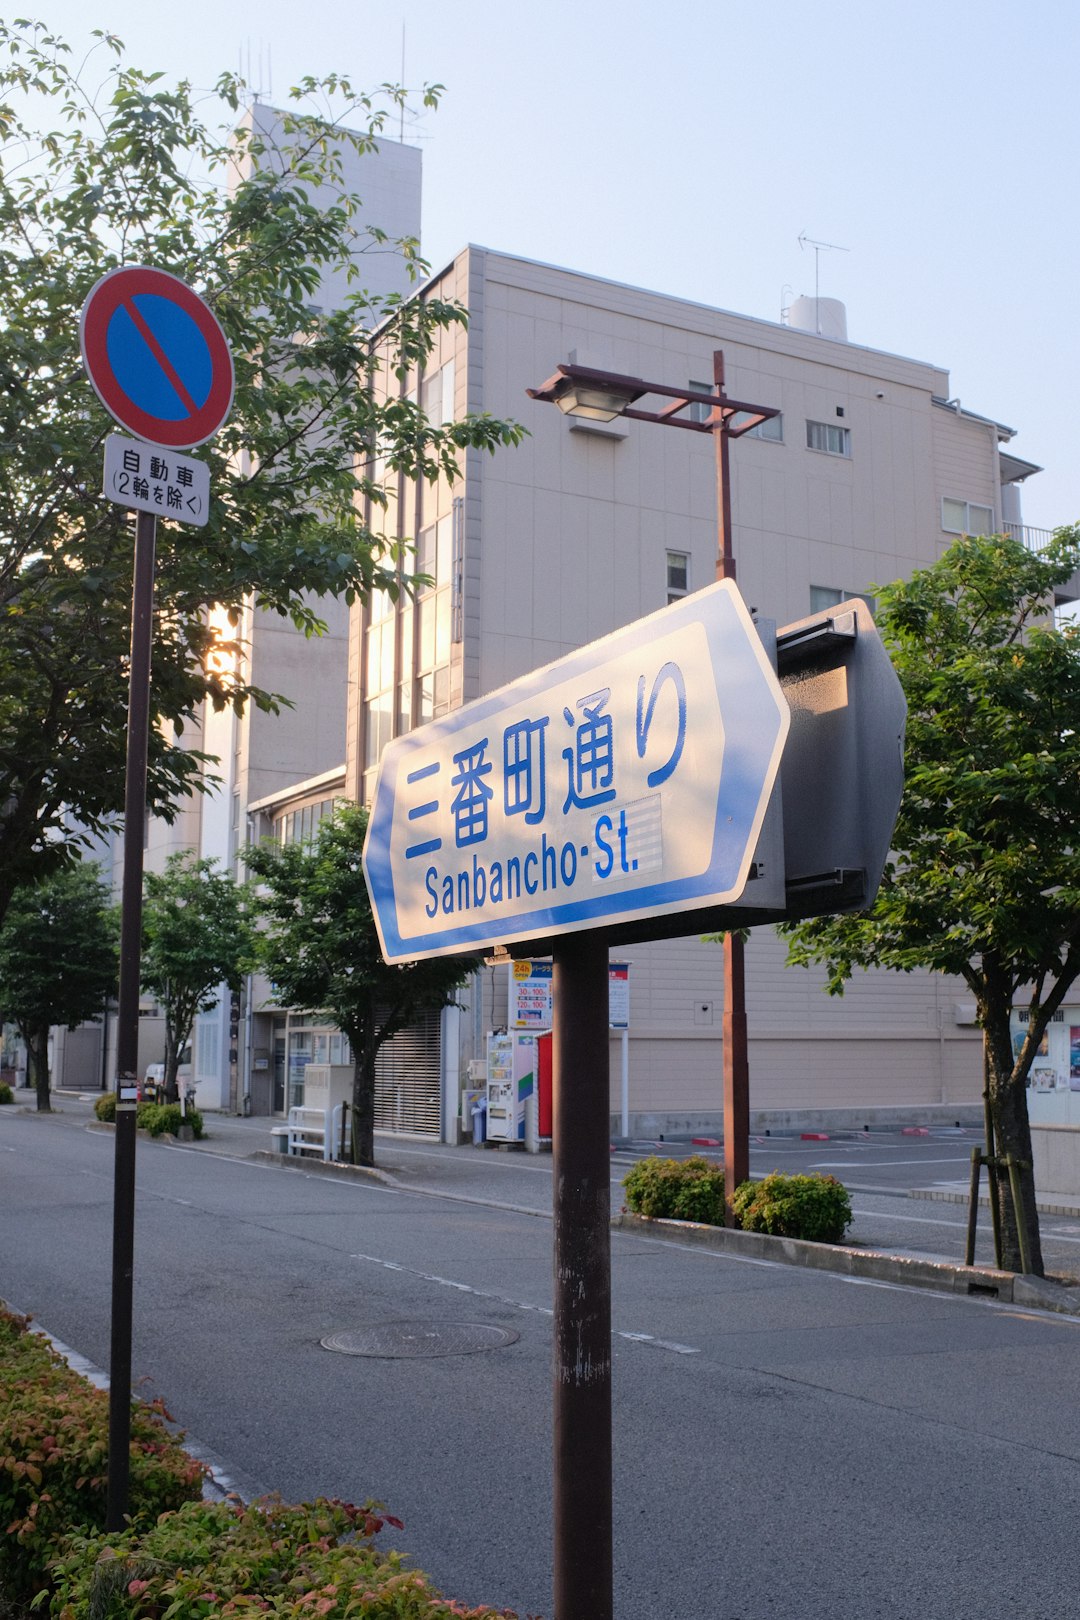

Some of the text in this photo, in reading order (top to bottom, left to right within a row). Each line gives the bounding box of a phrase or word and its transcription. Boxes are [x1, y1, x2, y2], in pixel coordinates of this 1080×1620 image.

[123, 449, 194, 488] 自動車
[113, 469, 202, 515] (2輪を除く)
[405, 661, 687, 860] 三番町通り
[514, 964, 530, 973] 24h
[532, 964, 552, 973] パークラ
[1018, 1010, 1064, 1023] 朝聞
